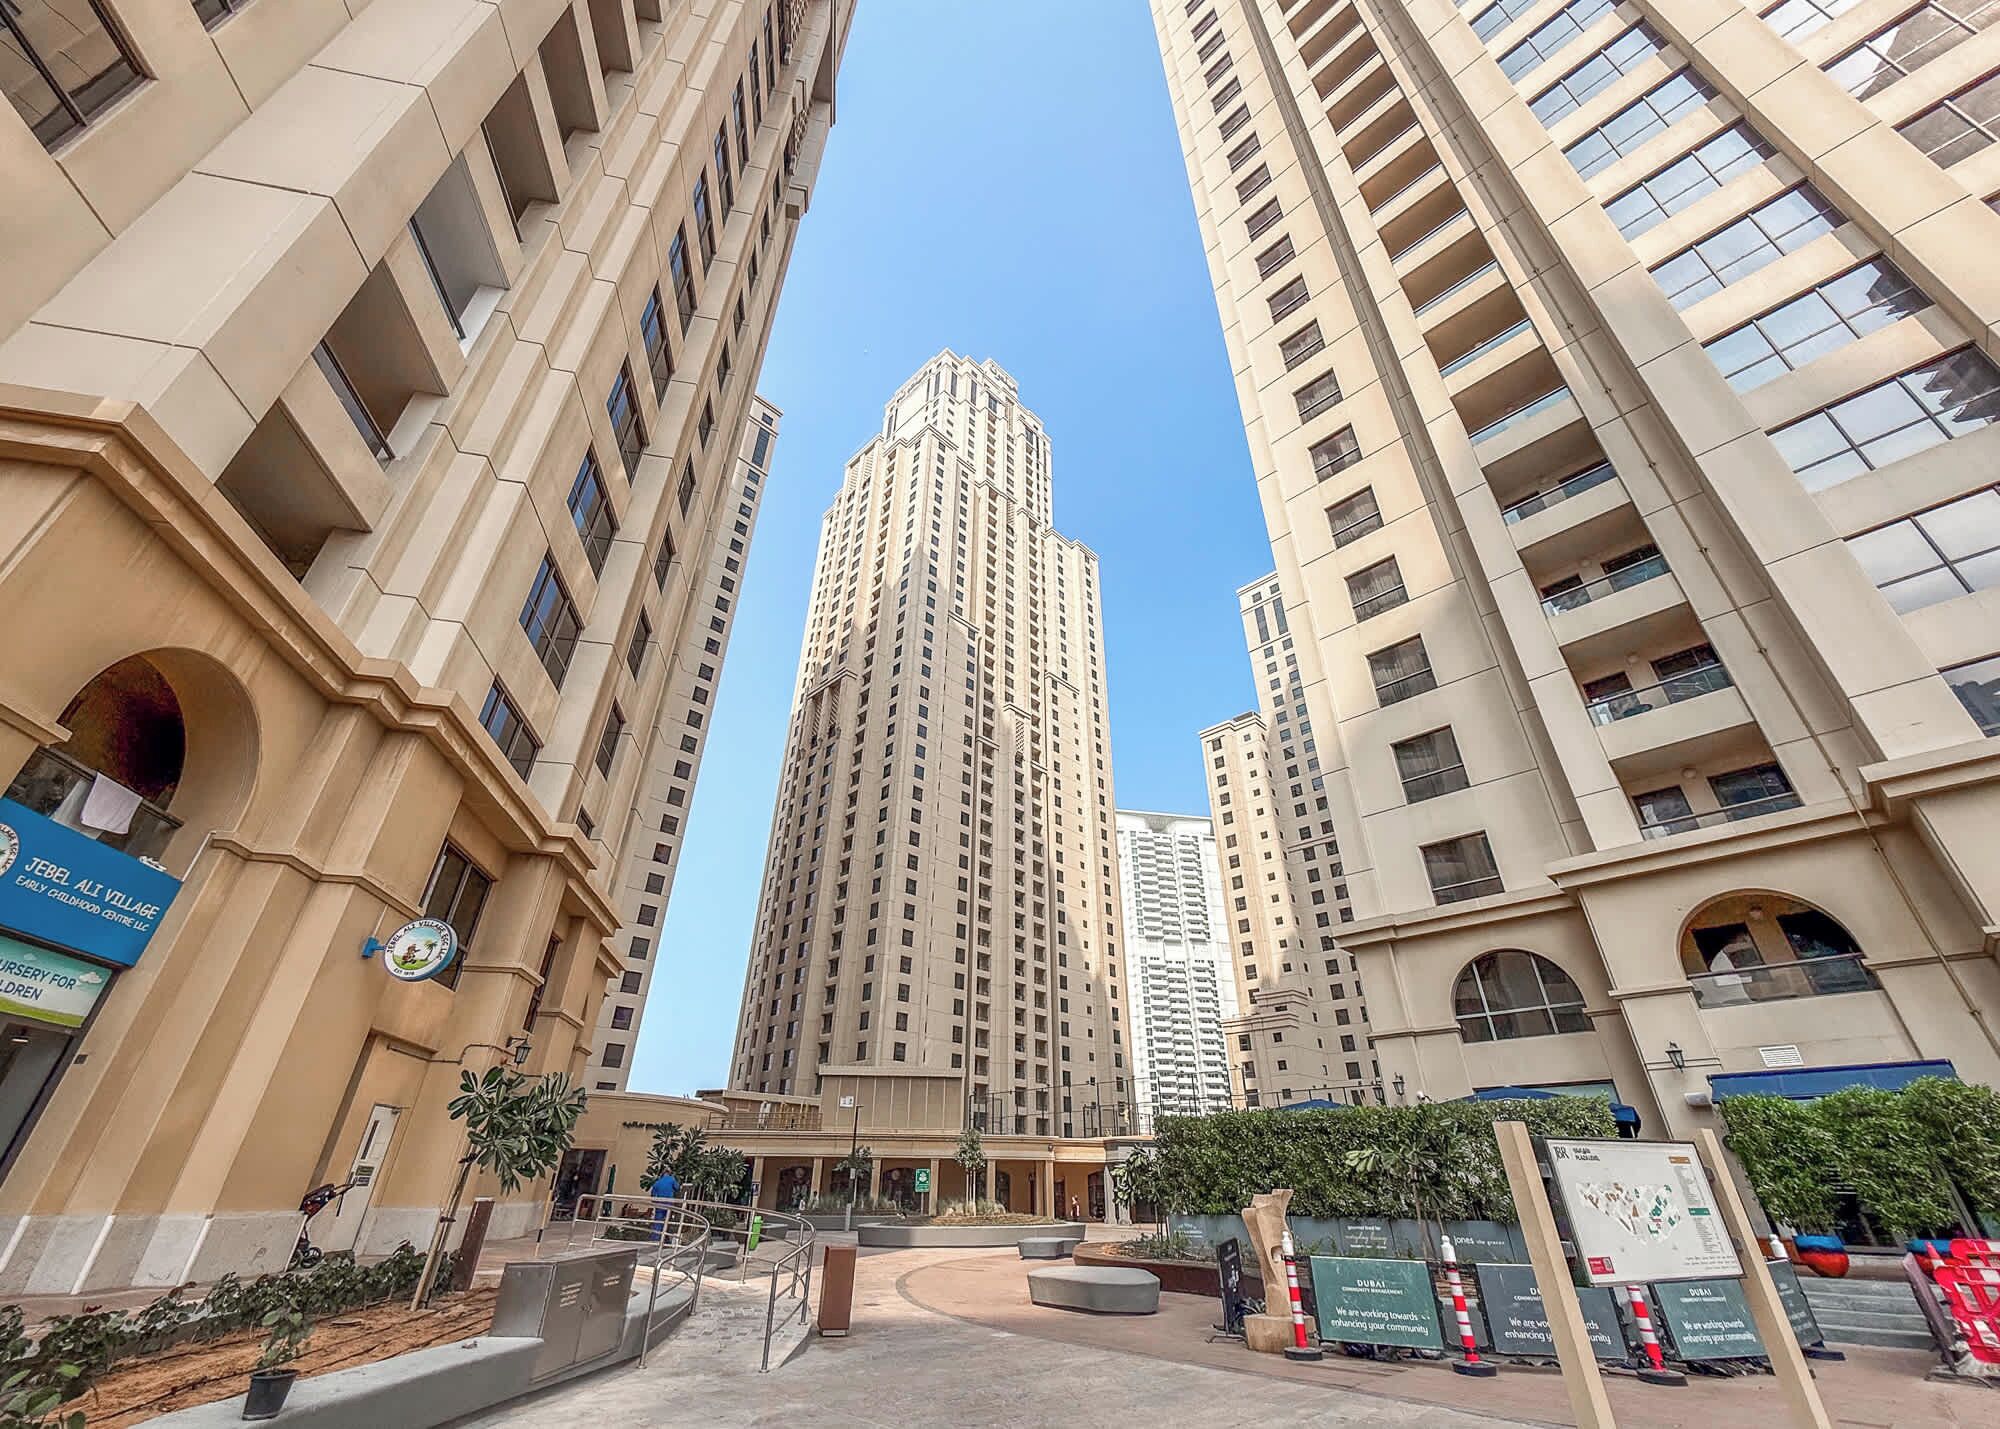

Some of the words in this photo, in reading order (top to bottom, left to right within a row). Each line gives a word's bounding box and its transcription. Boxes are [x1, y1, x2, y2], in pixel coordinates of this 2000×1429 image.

[25, 857, 71, 886] JEBEL
[74, 878, 104, 898] ALI
[104, 888, 160, 920] VILLAGE
[16, 875, 48, 893] EARLY
[47, 888, 101, 915] CHILDHOOD
[101, 909, 135, 928] CENTRE
[133, 920, 150, 932] LLC
[387, 934, 403, 953] JEBEL
[404, 924, 416, 933] ALI
[418, 921, 447, 934] VILLAGE
[0, 959, 51, 982] URSERY
[49, 973, 77, 990] FOR
[0, 979, 43, 1000] LDREN
[1357, 1280, 1385, 1288] DUBAI
[1689, 1288, 1712, 1297] DUBAI
[1336, 1306, 1347, 1316] We
[1360, 1309, 1389, 1321] working
[1390, 1311, 1419, 1321] towards
[1331, 1318, 1368, 1331] enhancing
[1368, 1322, 1386, 1332] your
[1387, 1323, 1429, 1336] community
[1509, 1317, 1521, 1327] We
[1523, 1320, 1536, 1328] are
[1505, 1329, 1545, 1341] enhancing
[1590, 1333, 1612, 1345] unity
